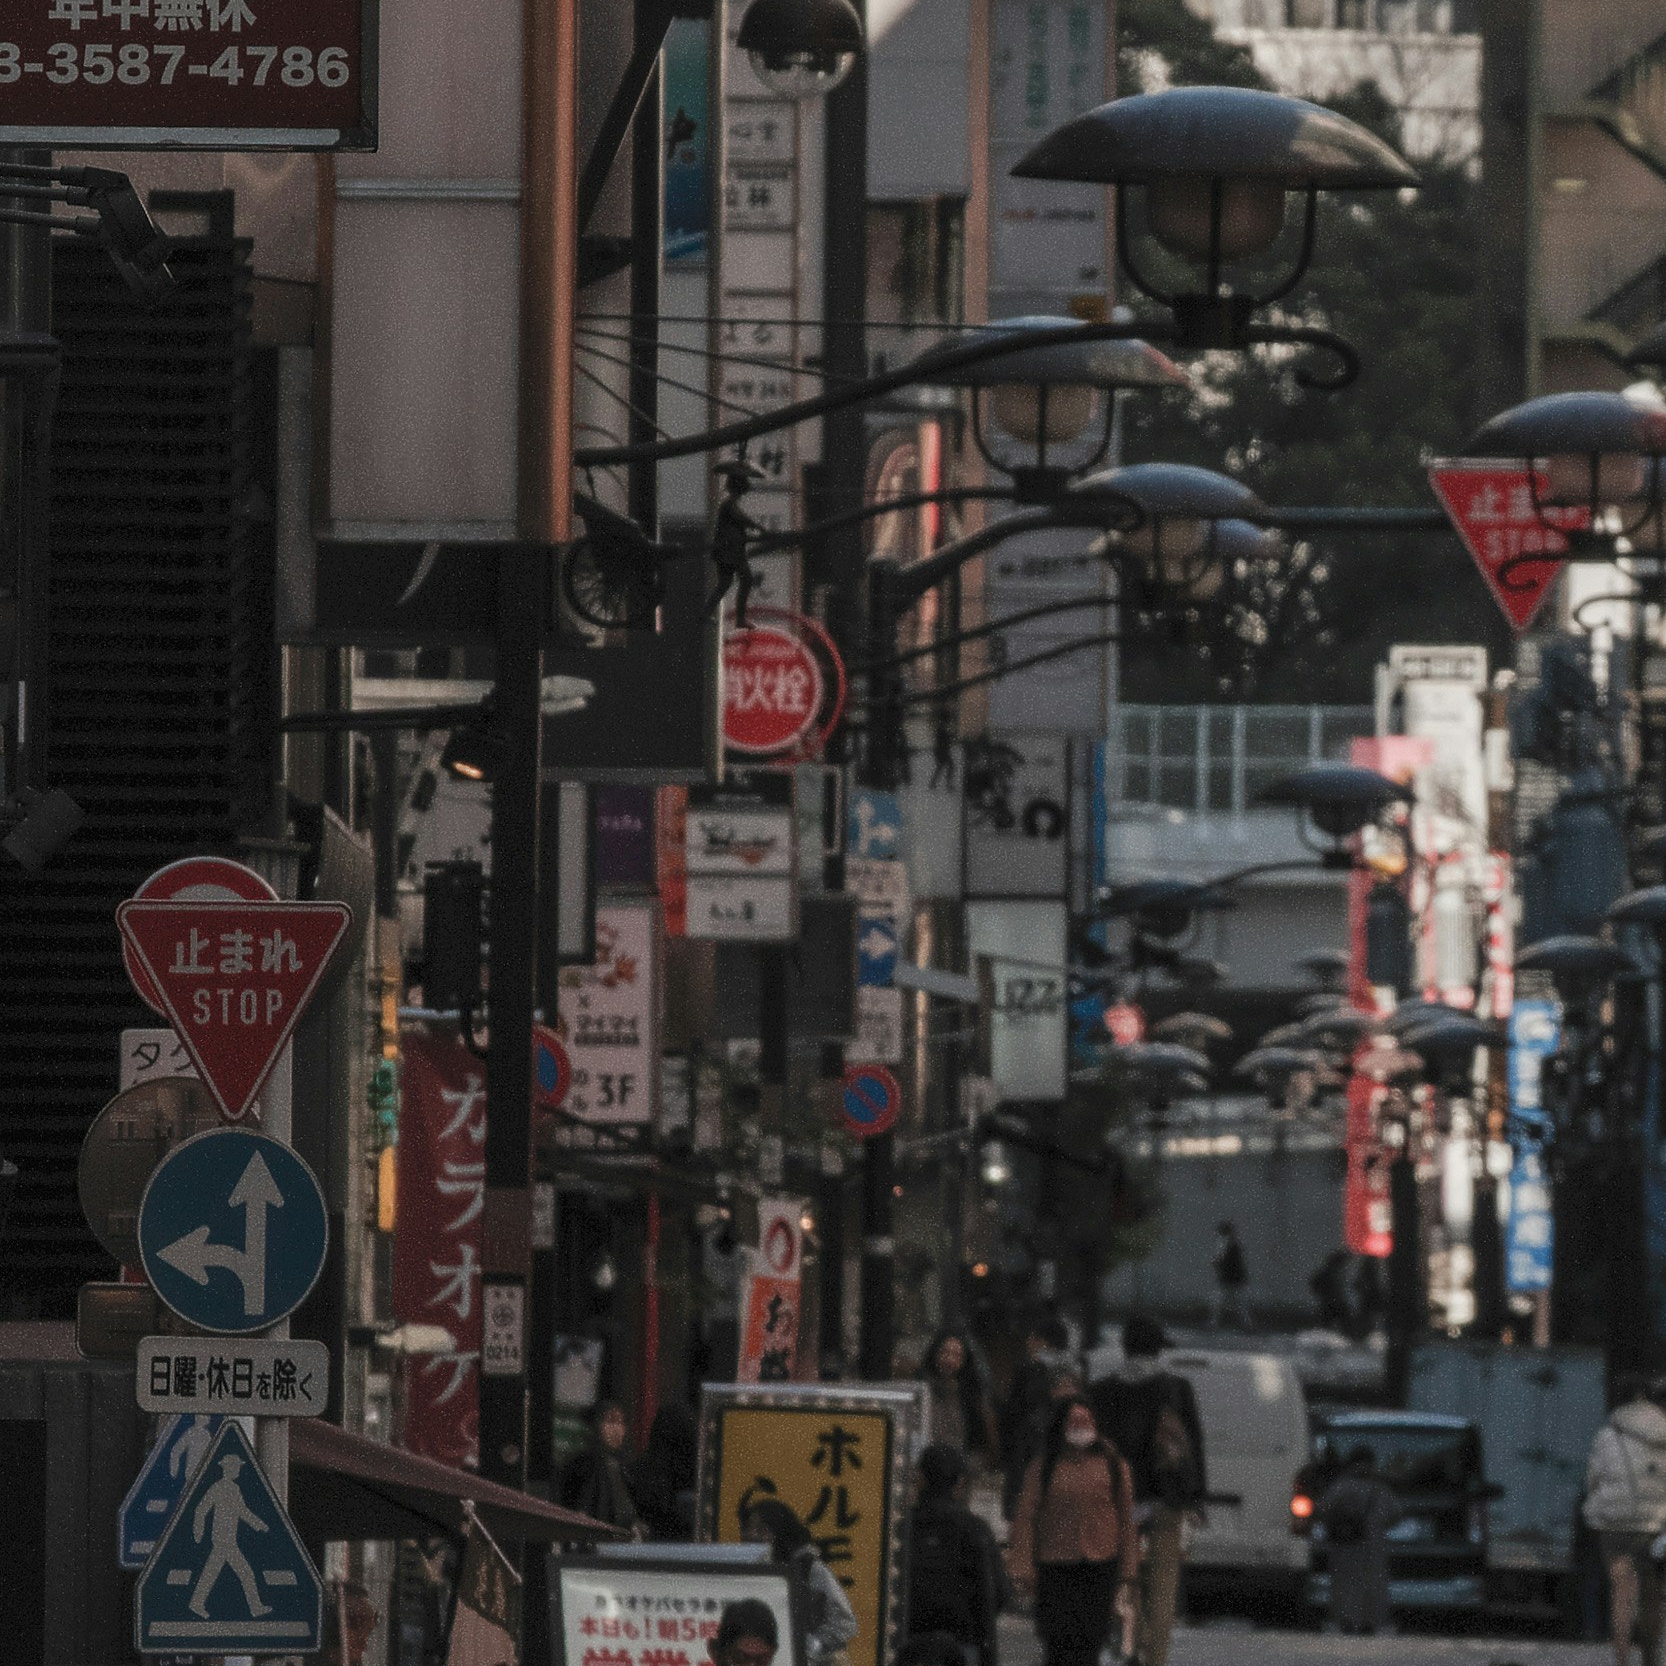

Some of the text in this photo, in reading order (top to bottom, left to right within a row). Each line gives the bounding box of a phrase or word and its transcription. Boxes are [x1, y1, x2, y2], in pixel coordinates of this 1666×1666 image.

[168, 927, 303, 975] 止まれ
[192, 988, 284, 1026] STOP
[598, 1074, 637, 1106] 3F
[420, 1070, 488, 1407] カラオケ
[149, 1355, 313, 1401] 日曜・休日を除く
